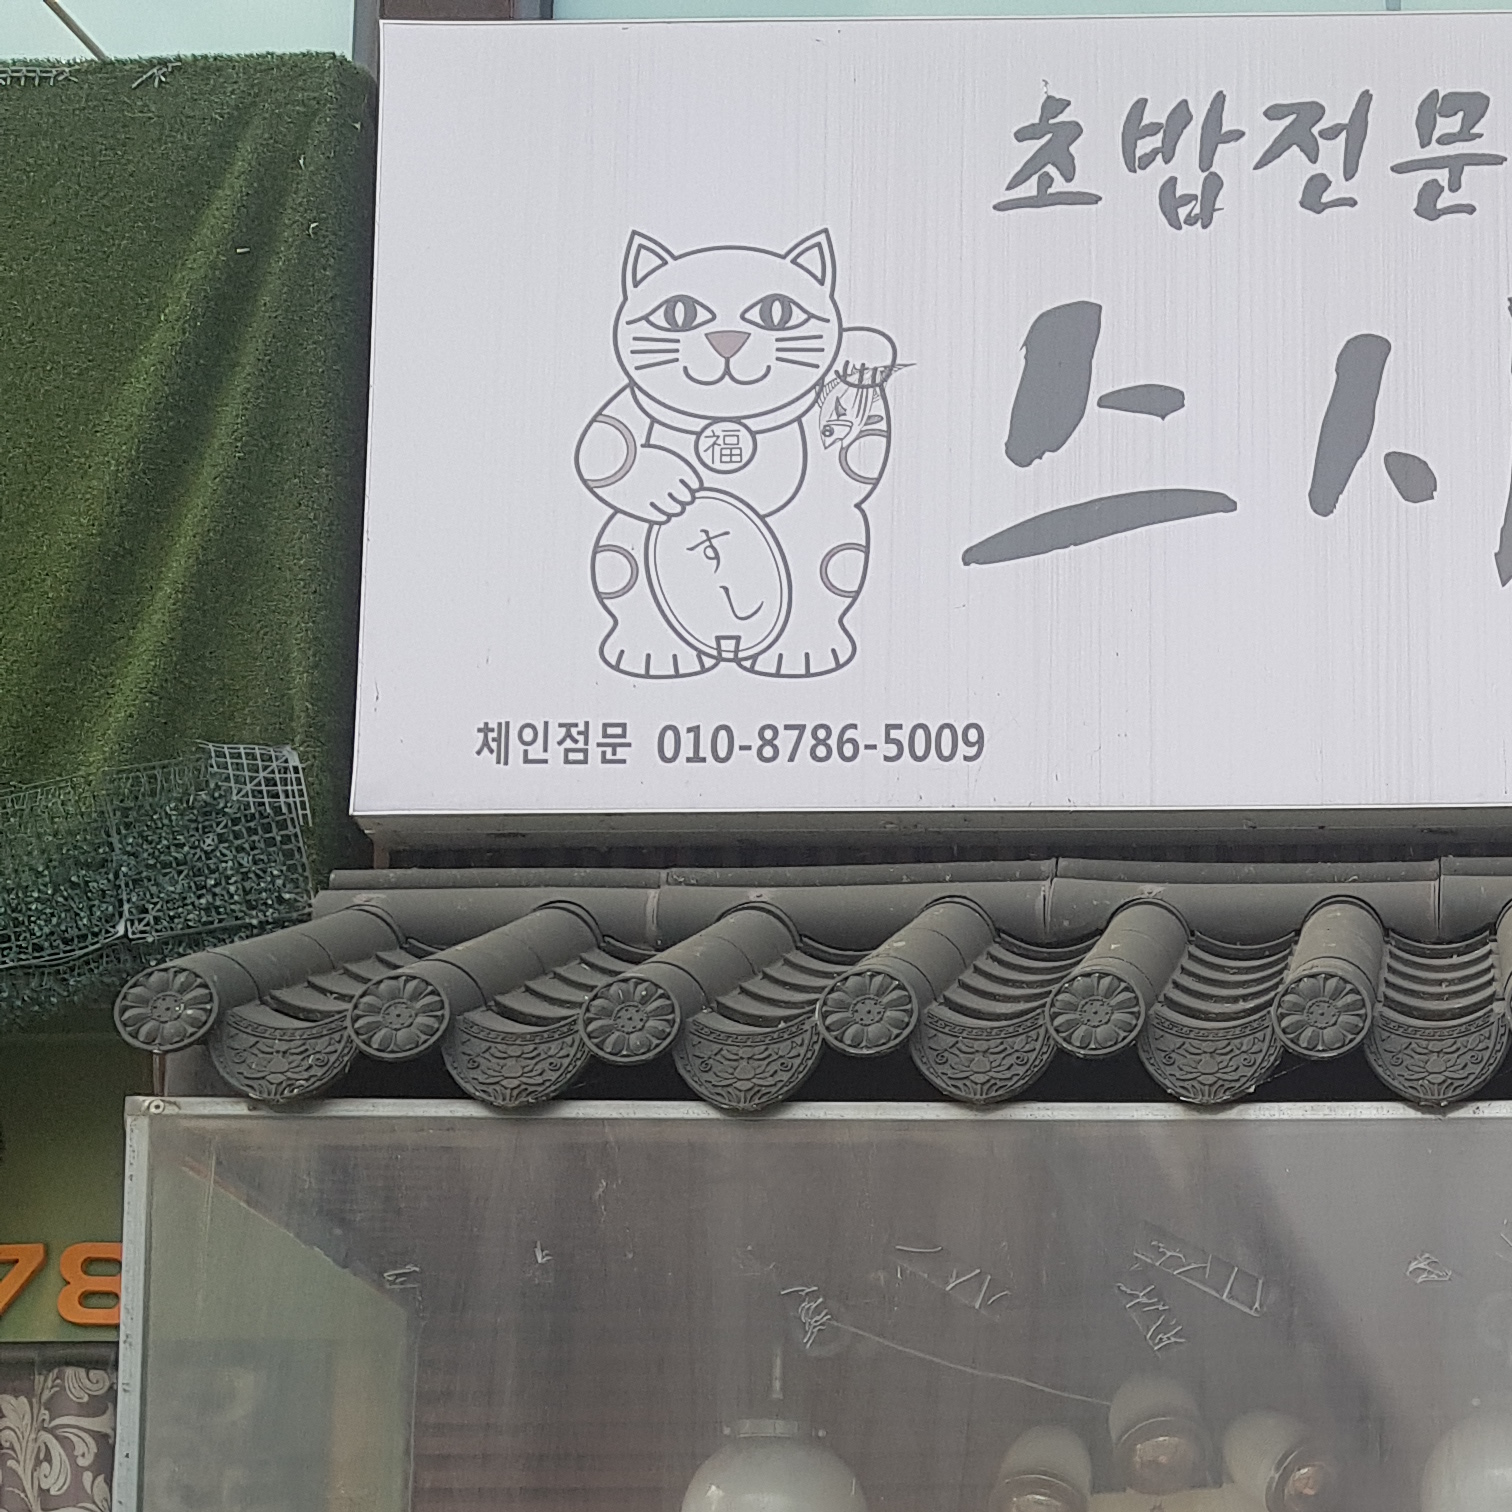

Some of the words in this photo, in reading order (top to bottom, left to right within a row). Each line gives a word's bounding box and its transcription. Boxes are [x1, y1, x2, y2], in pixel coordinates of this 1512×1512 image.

[703, 427, 744, 466] 福
[475, 720, 632, 767] 체인점문
[656, 723, 985, 765] 010-8786-5009
